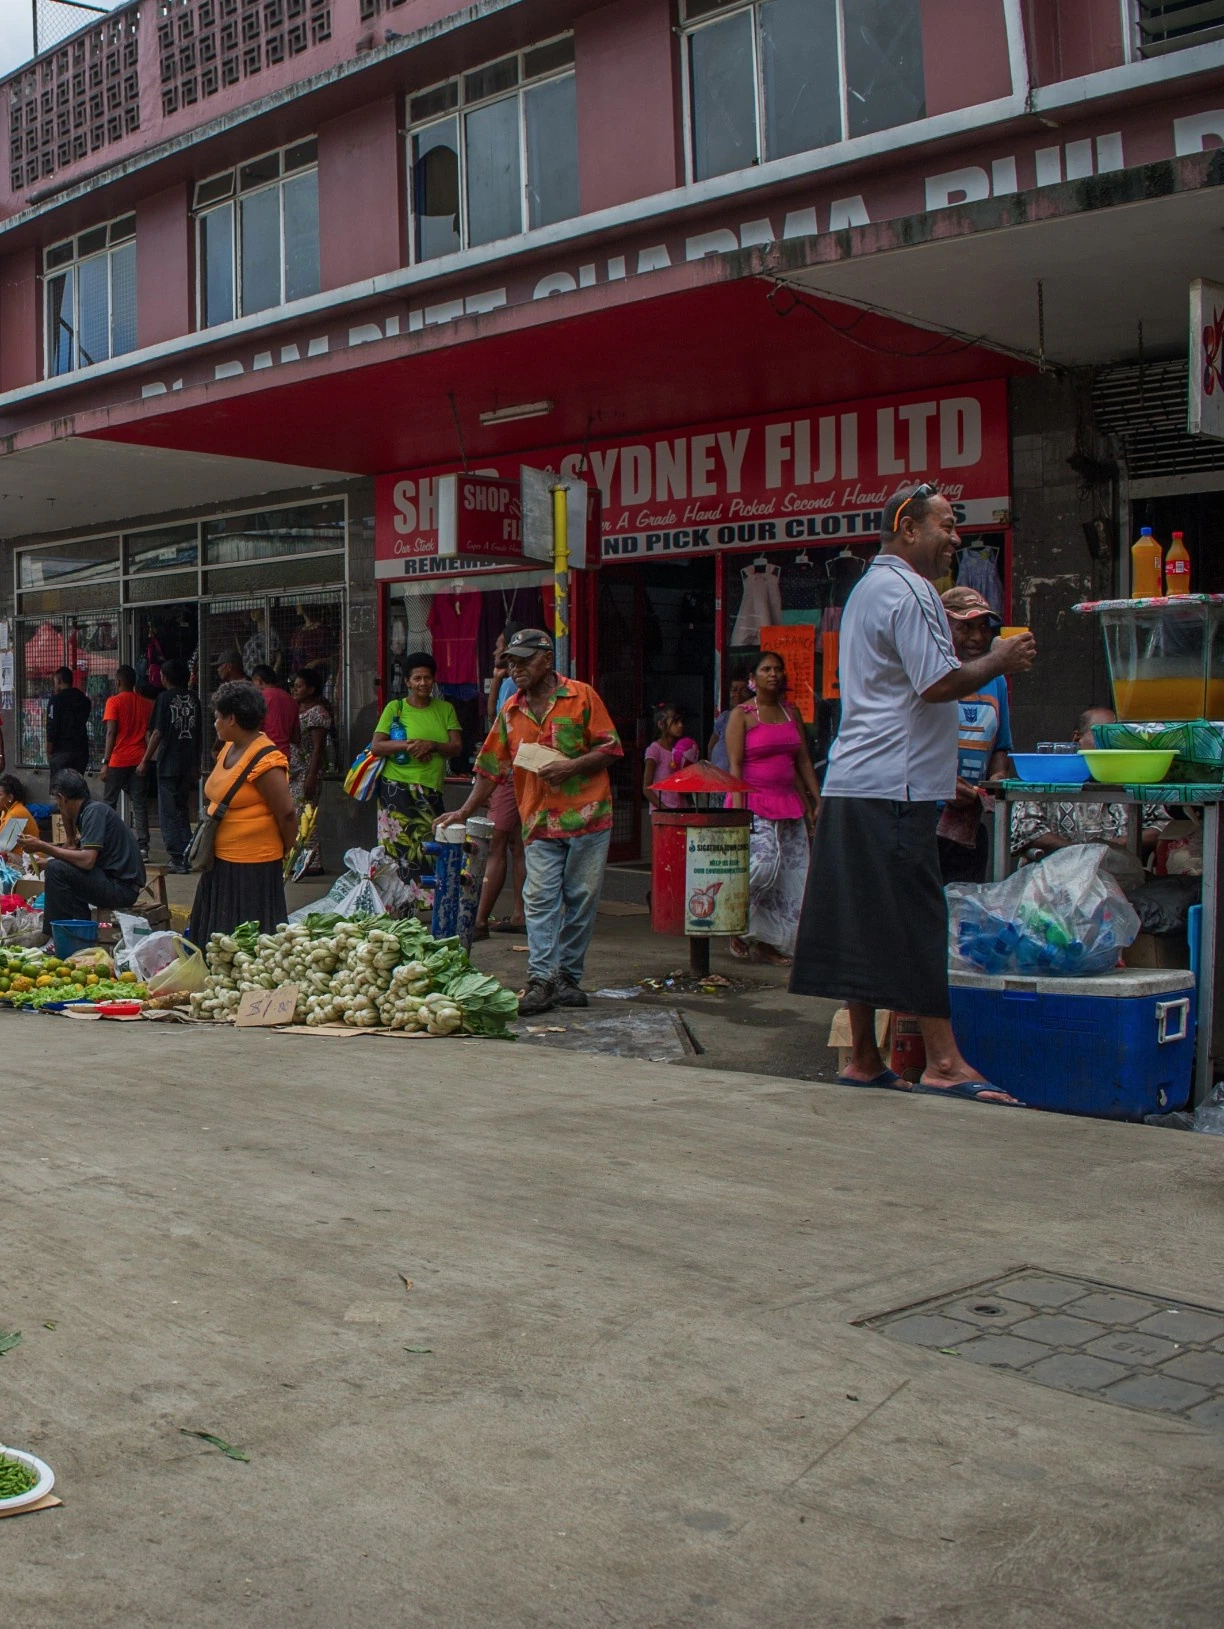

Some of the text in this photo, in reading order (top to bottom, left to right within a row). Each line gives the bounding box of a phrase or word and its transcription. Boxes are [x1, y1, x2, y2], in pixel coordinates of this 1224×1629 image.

[765, 412, 859, 489] FIJI
[877, 396, 982, 477] LTD
[463, 483, 510, 513] SHOP
[616, 511, 629, 530] A
[635, 508, 677, 527] Grade
[683, 502, 723, 523] Hand
[728, 497, 775, 519] Picked
[781, 491, 835, 513] Second
[841, 483, 887, 506] Hand
[503, 518, 522, 541] FI
[604, 536, 638, 555] ND
[645, 529, 710, 552] PICK
[717, 522, 777, 545] OUR
[394, 537, 435, 555] Our Stock
